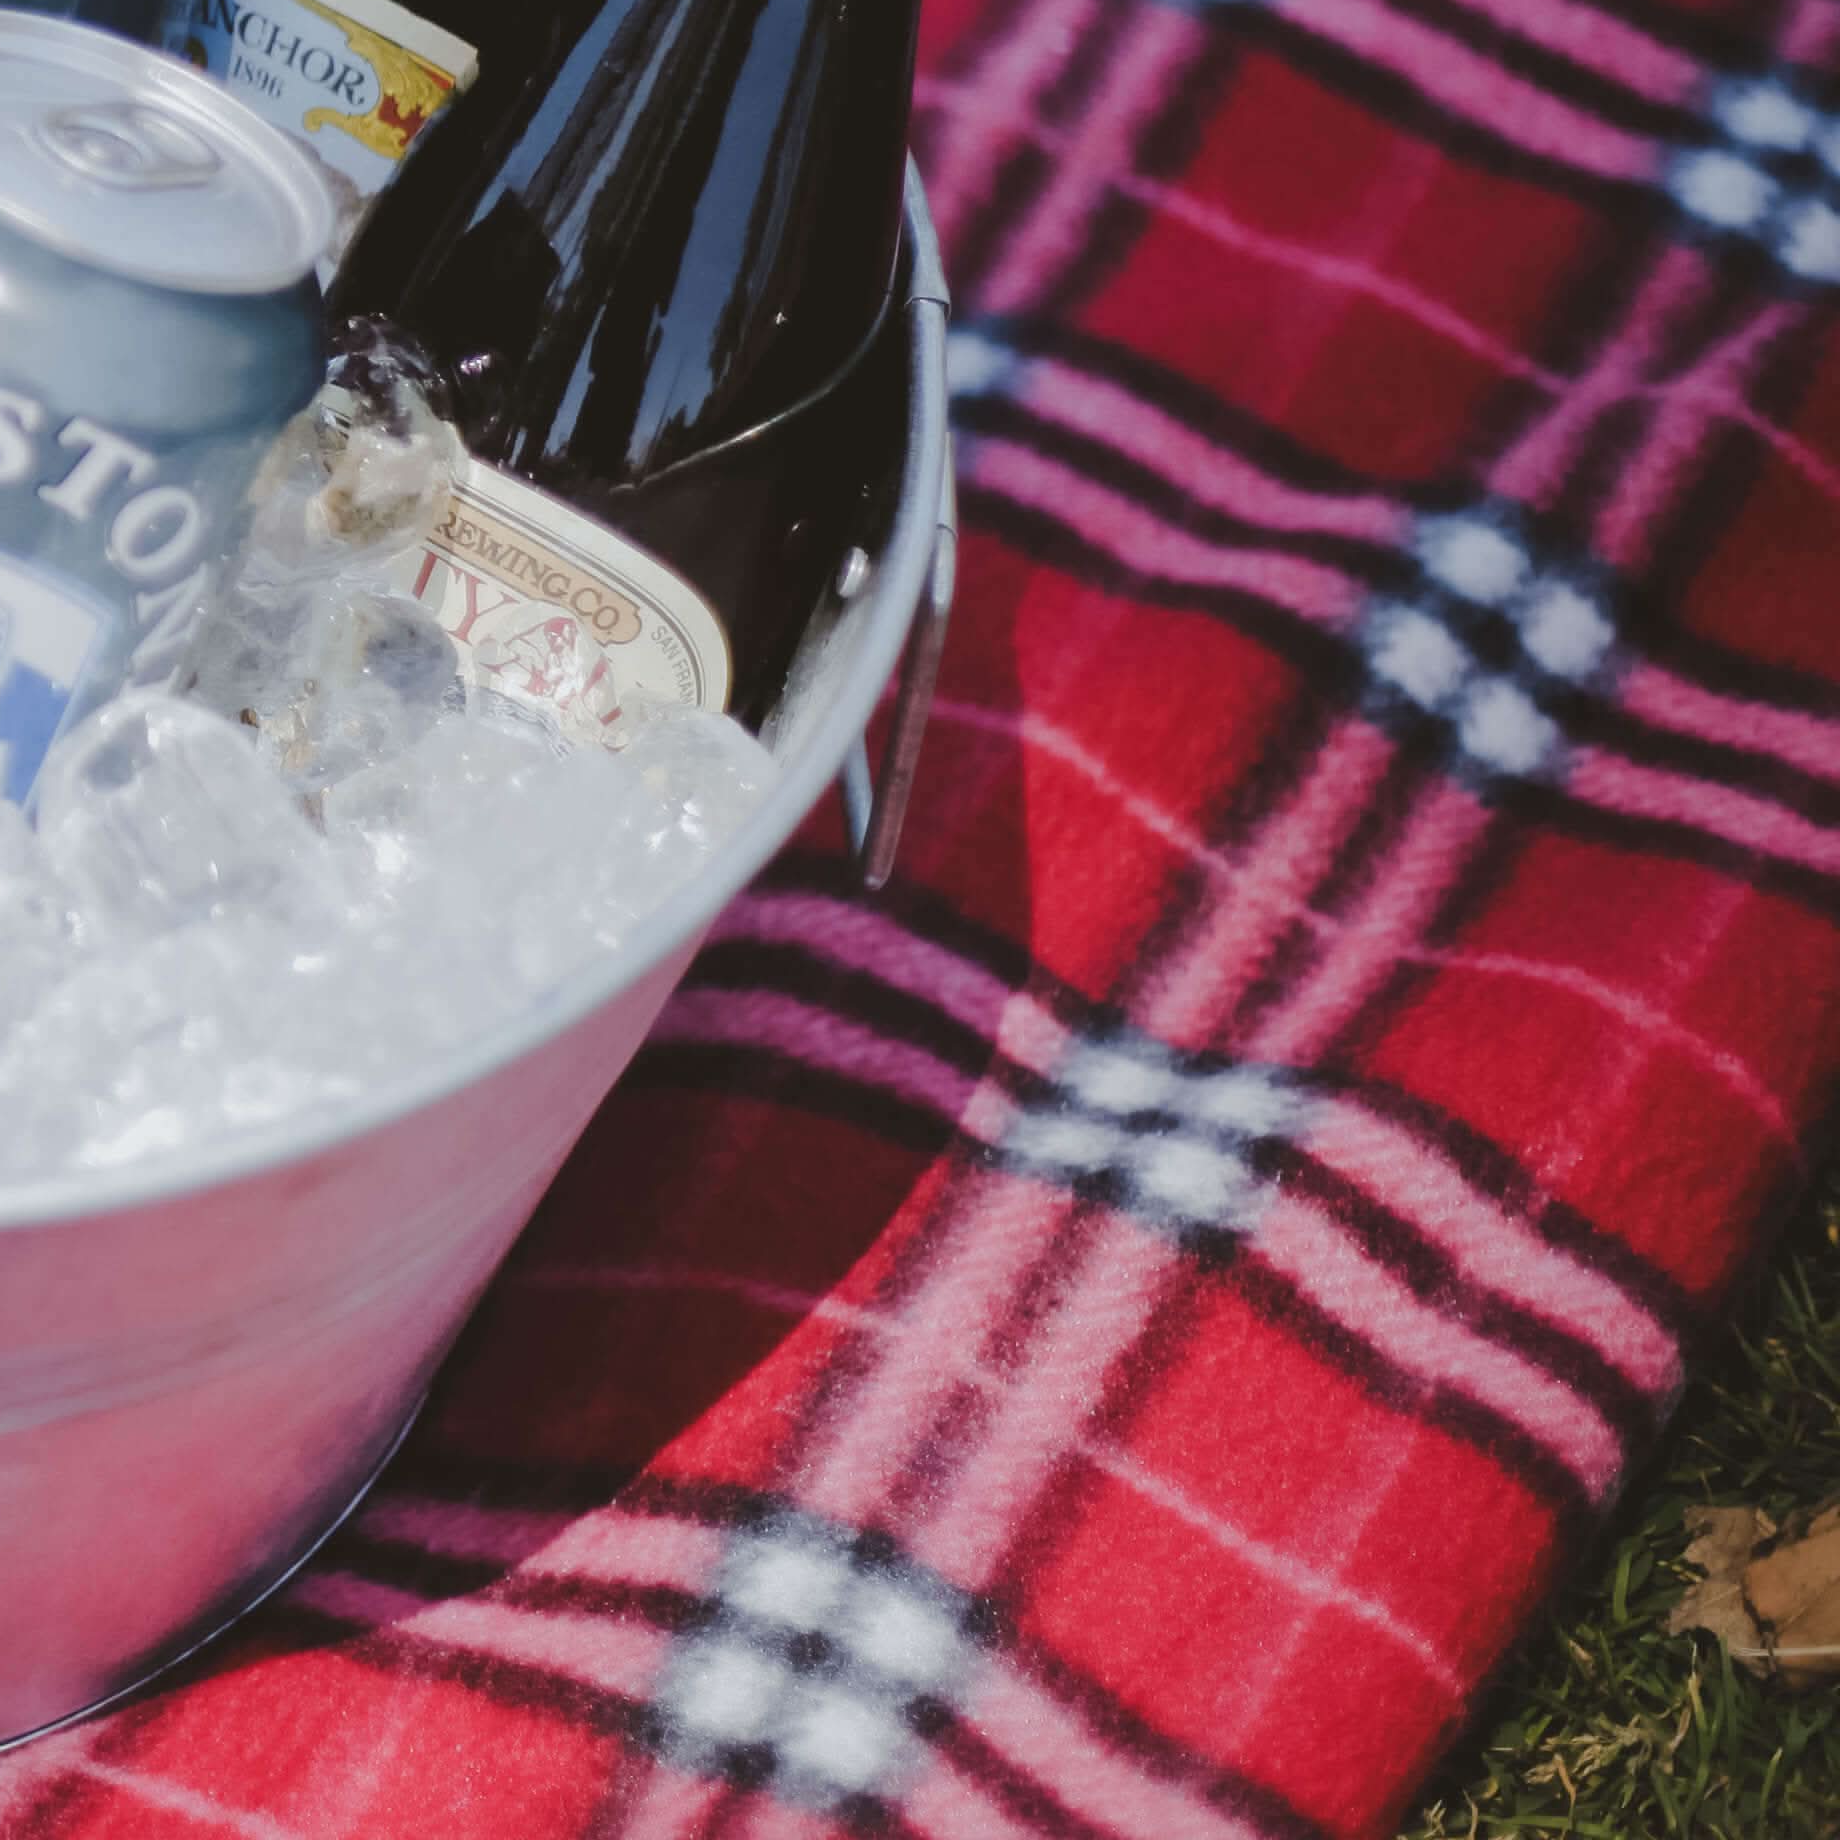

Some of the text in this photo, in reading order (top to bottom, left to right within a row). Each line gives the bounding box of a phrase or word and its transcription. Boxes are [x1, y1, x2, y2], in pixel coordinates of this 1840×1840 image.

[231, 54, 282, 101] 1896
[570, 586, 620, 635] CO.
[650, 624, 681, 661] SAN
